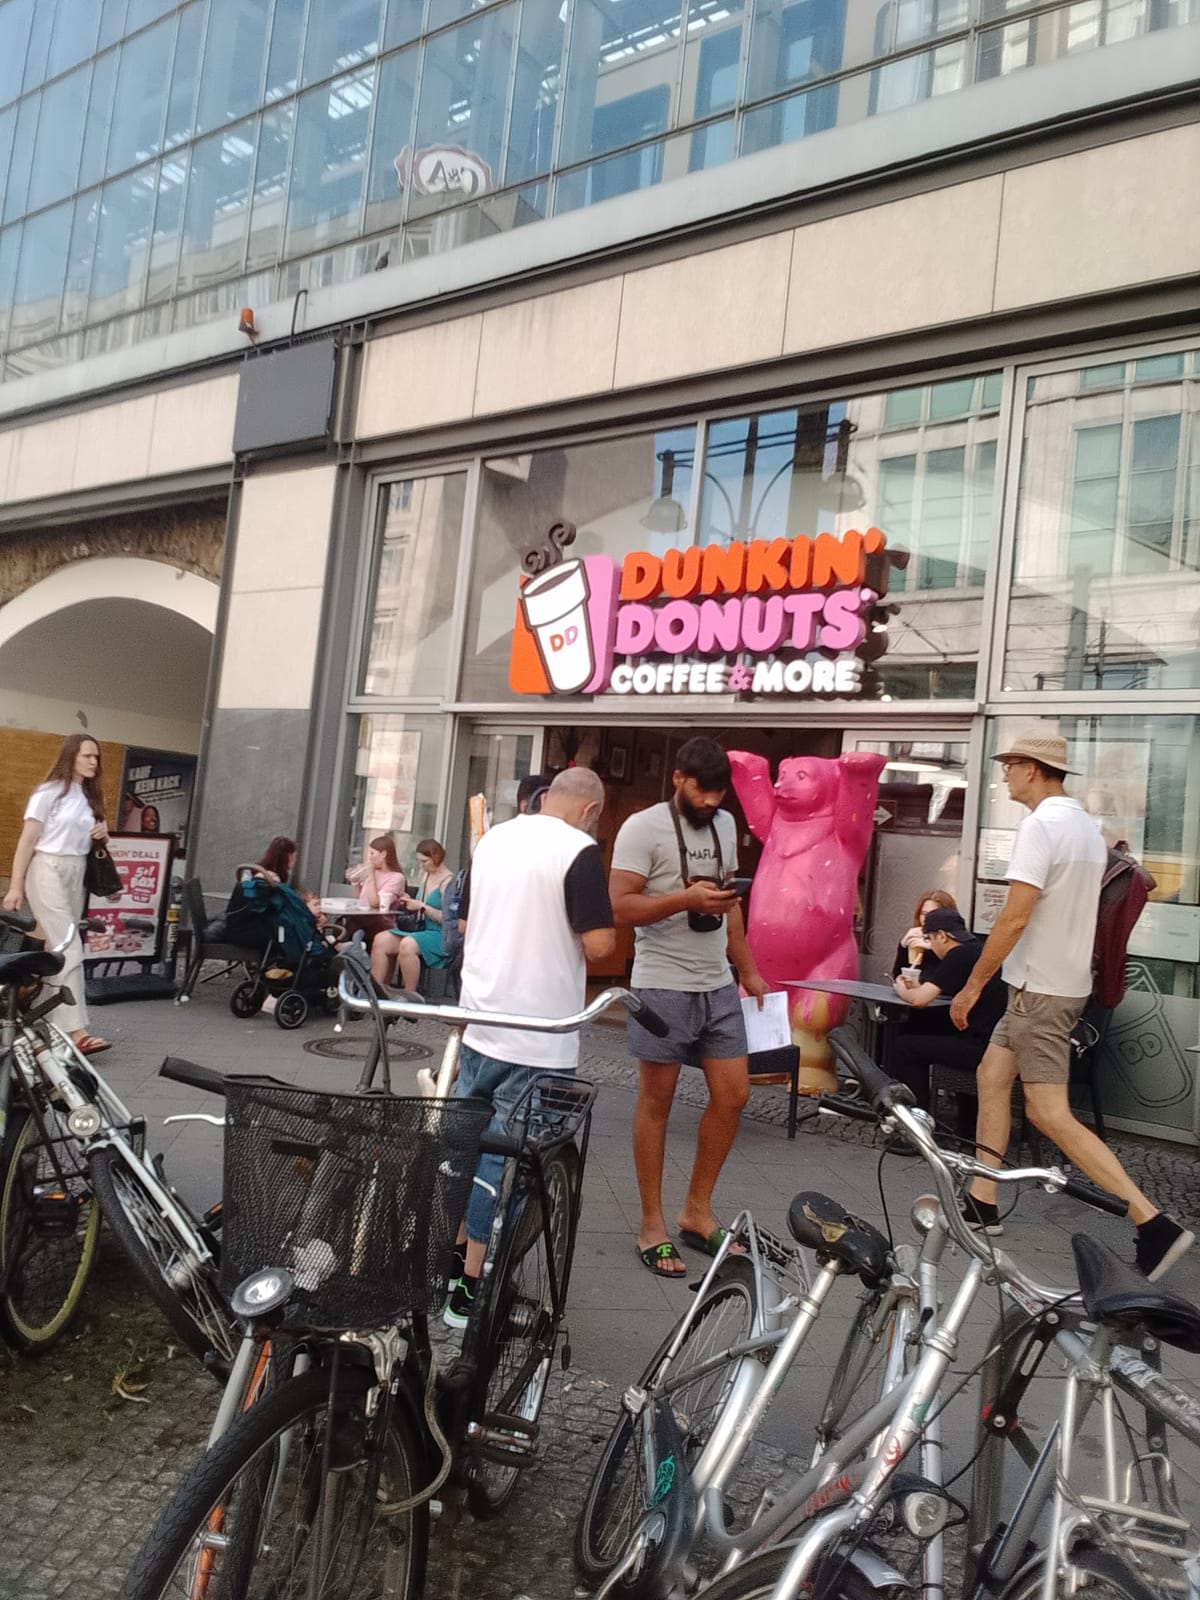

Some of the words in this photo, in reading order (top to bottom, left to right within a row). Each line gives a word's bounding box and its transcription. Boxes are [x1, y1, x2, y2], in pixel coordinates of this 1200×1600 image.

[620, 528, 885, 600] DUNKIN'
[549, 625, 578, 652] DD
[614, 590, 867, 655] DONUTS
[610, 663, 725, 694] COFFEE
[728, 664, 751, 691] &
[751, 660, 862, 694] MORE
